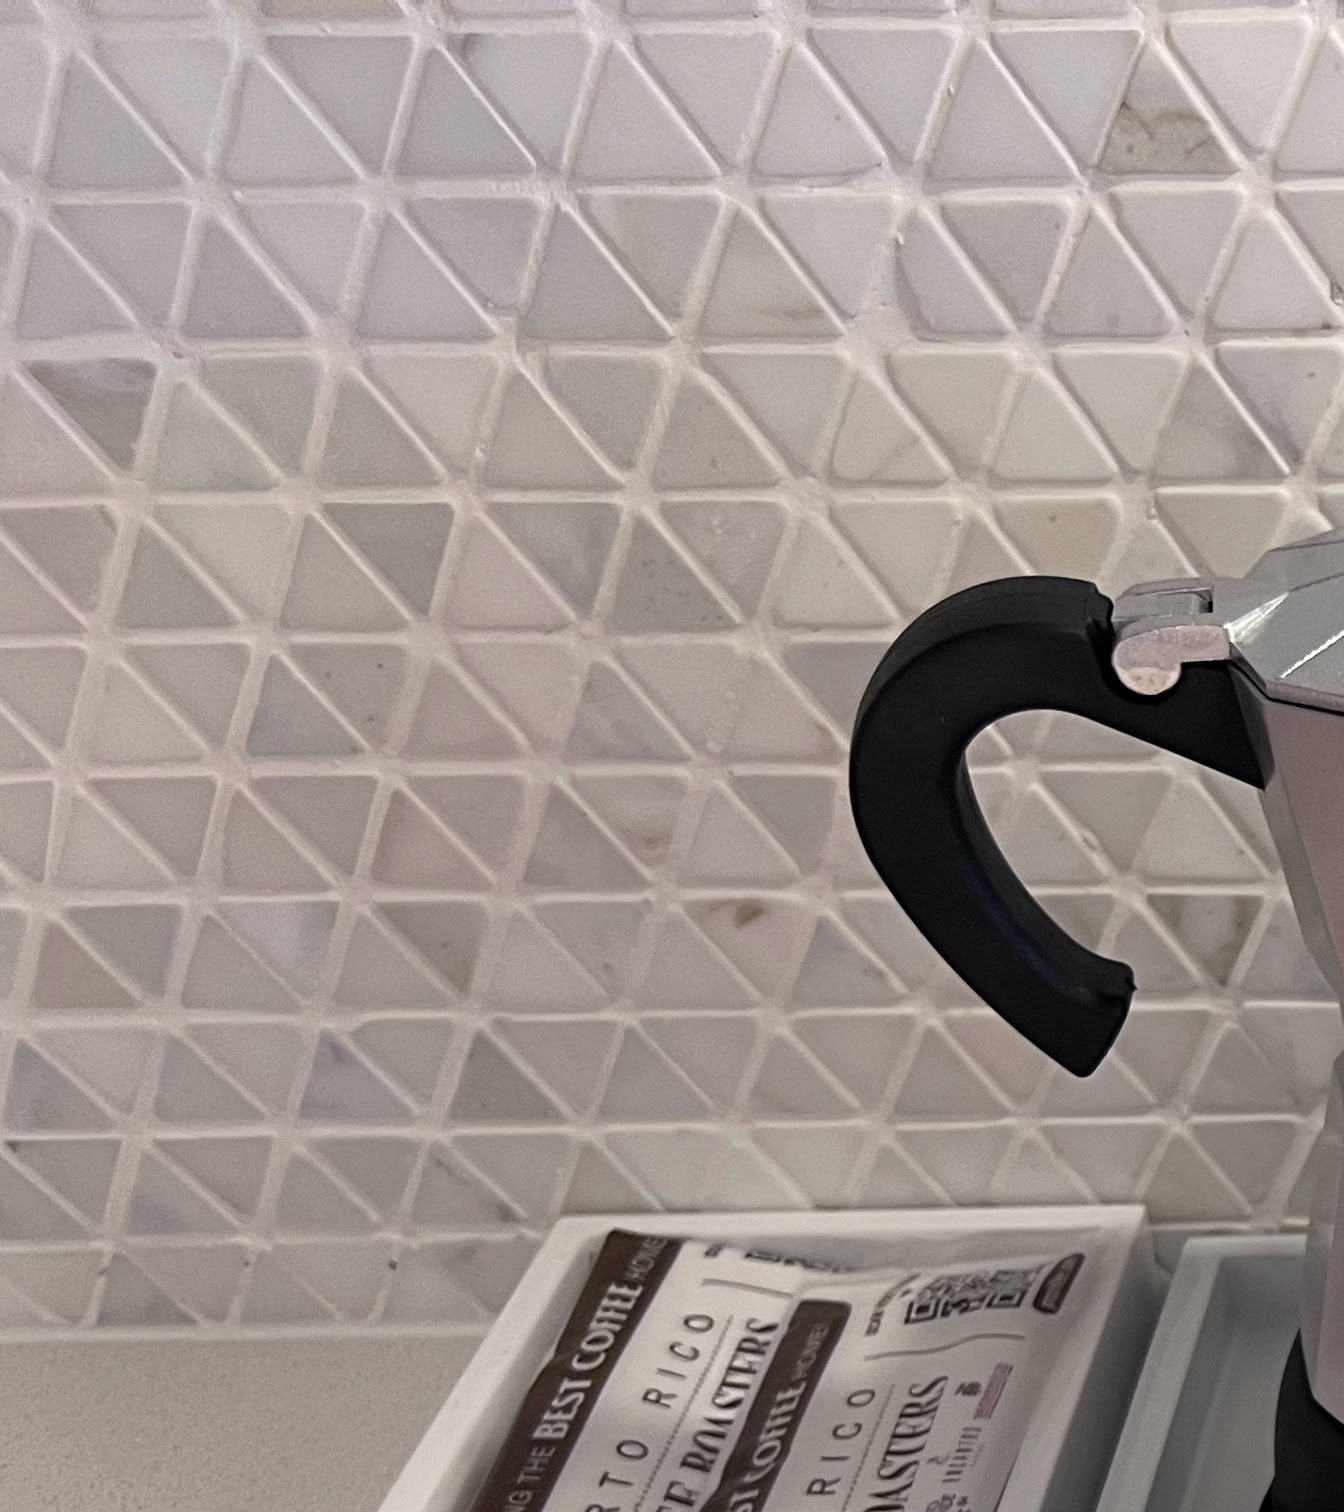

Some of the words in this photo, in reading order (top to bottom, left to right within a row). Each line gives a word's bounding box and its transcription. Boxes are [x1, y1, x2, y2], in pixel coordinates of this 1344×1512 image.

[642, 1314, 714, 1409] RICO
[532, 1378, 593, 1440] BEST
[806, 1389, 876, 1496] RICO
[518, 1446, 556, 1489] THE
